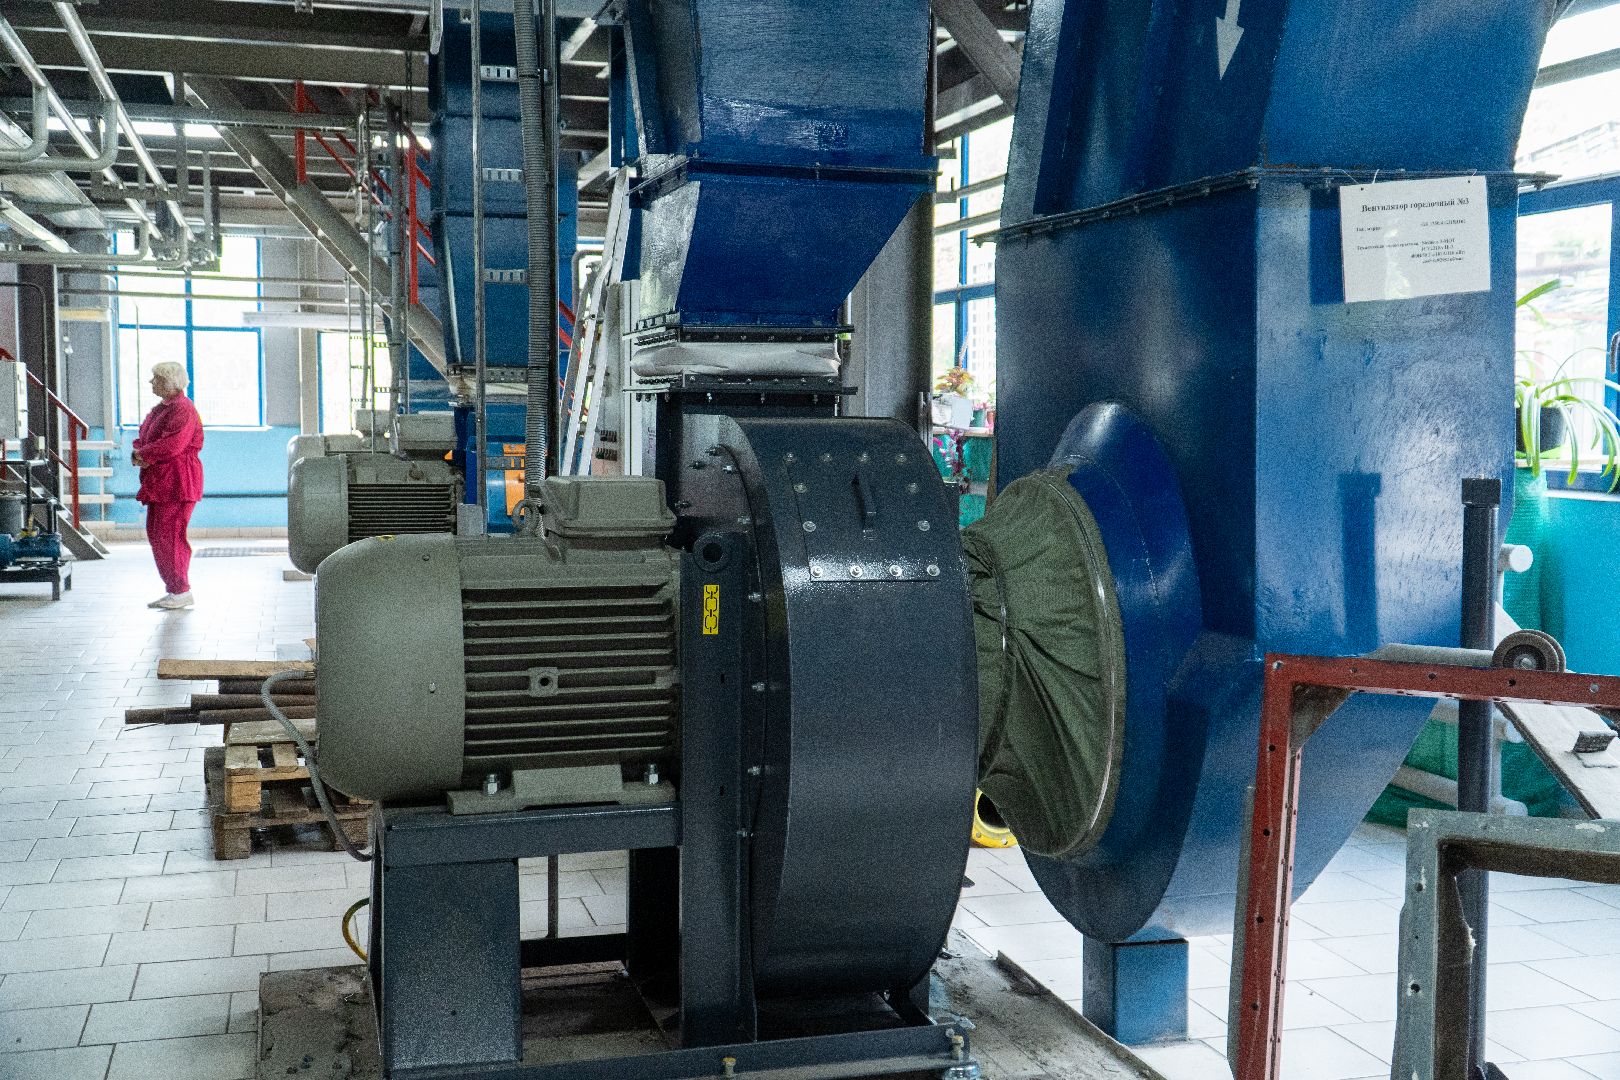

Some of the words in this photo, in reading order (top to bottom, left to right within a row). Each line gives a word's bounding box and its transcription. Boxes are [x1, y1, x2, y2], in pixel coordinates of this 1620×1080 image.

[1361, 203, 1408, 213] Вентилятор
[1410, 198, 1455, 211] горелочный
[1457, 197, 1470, 206] №3
